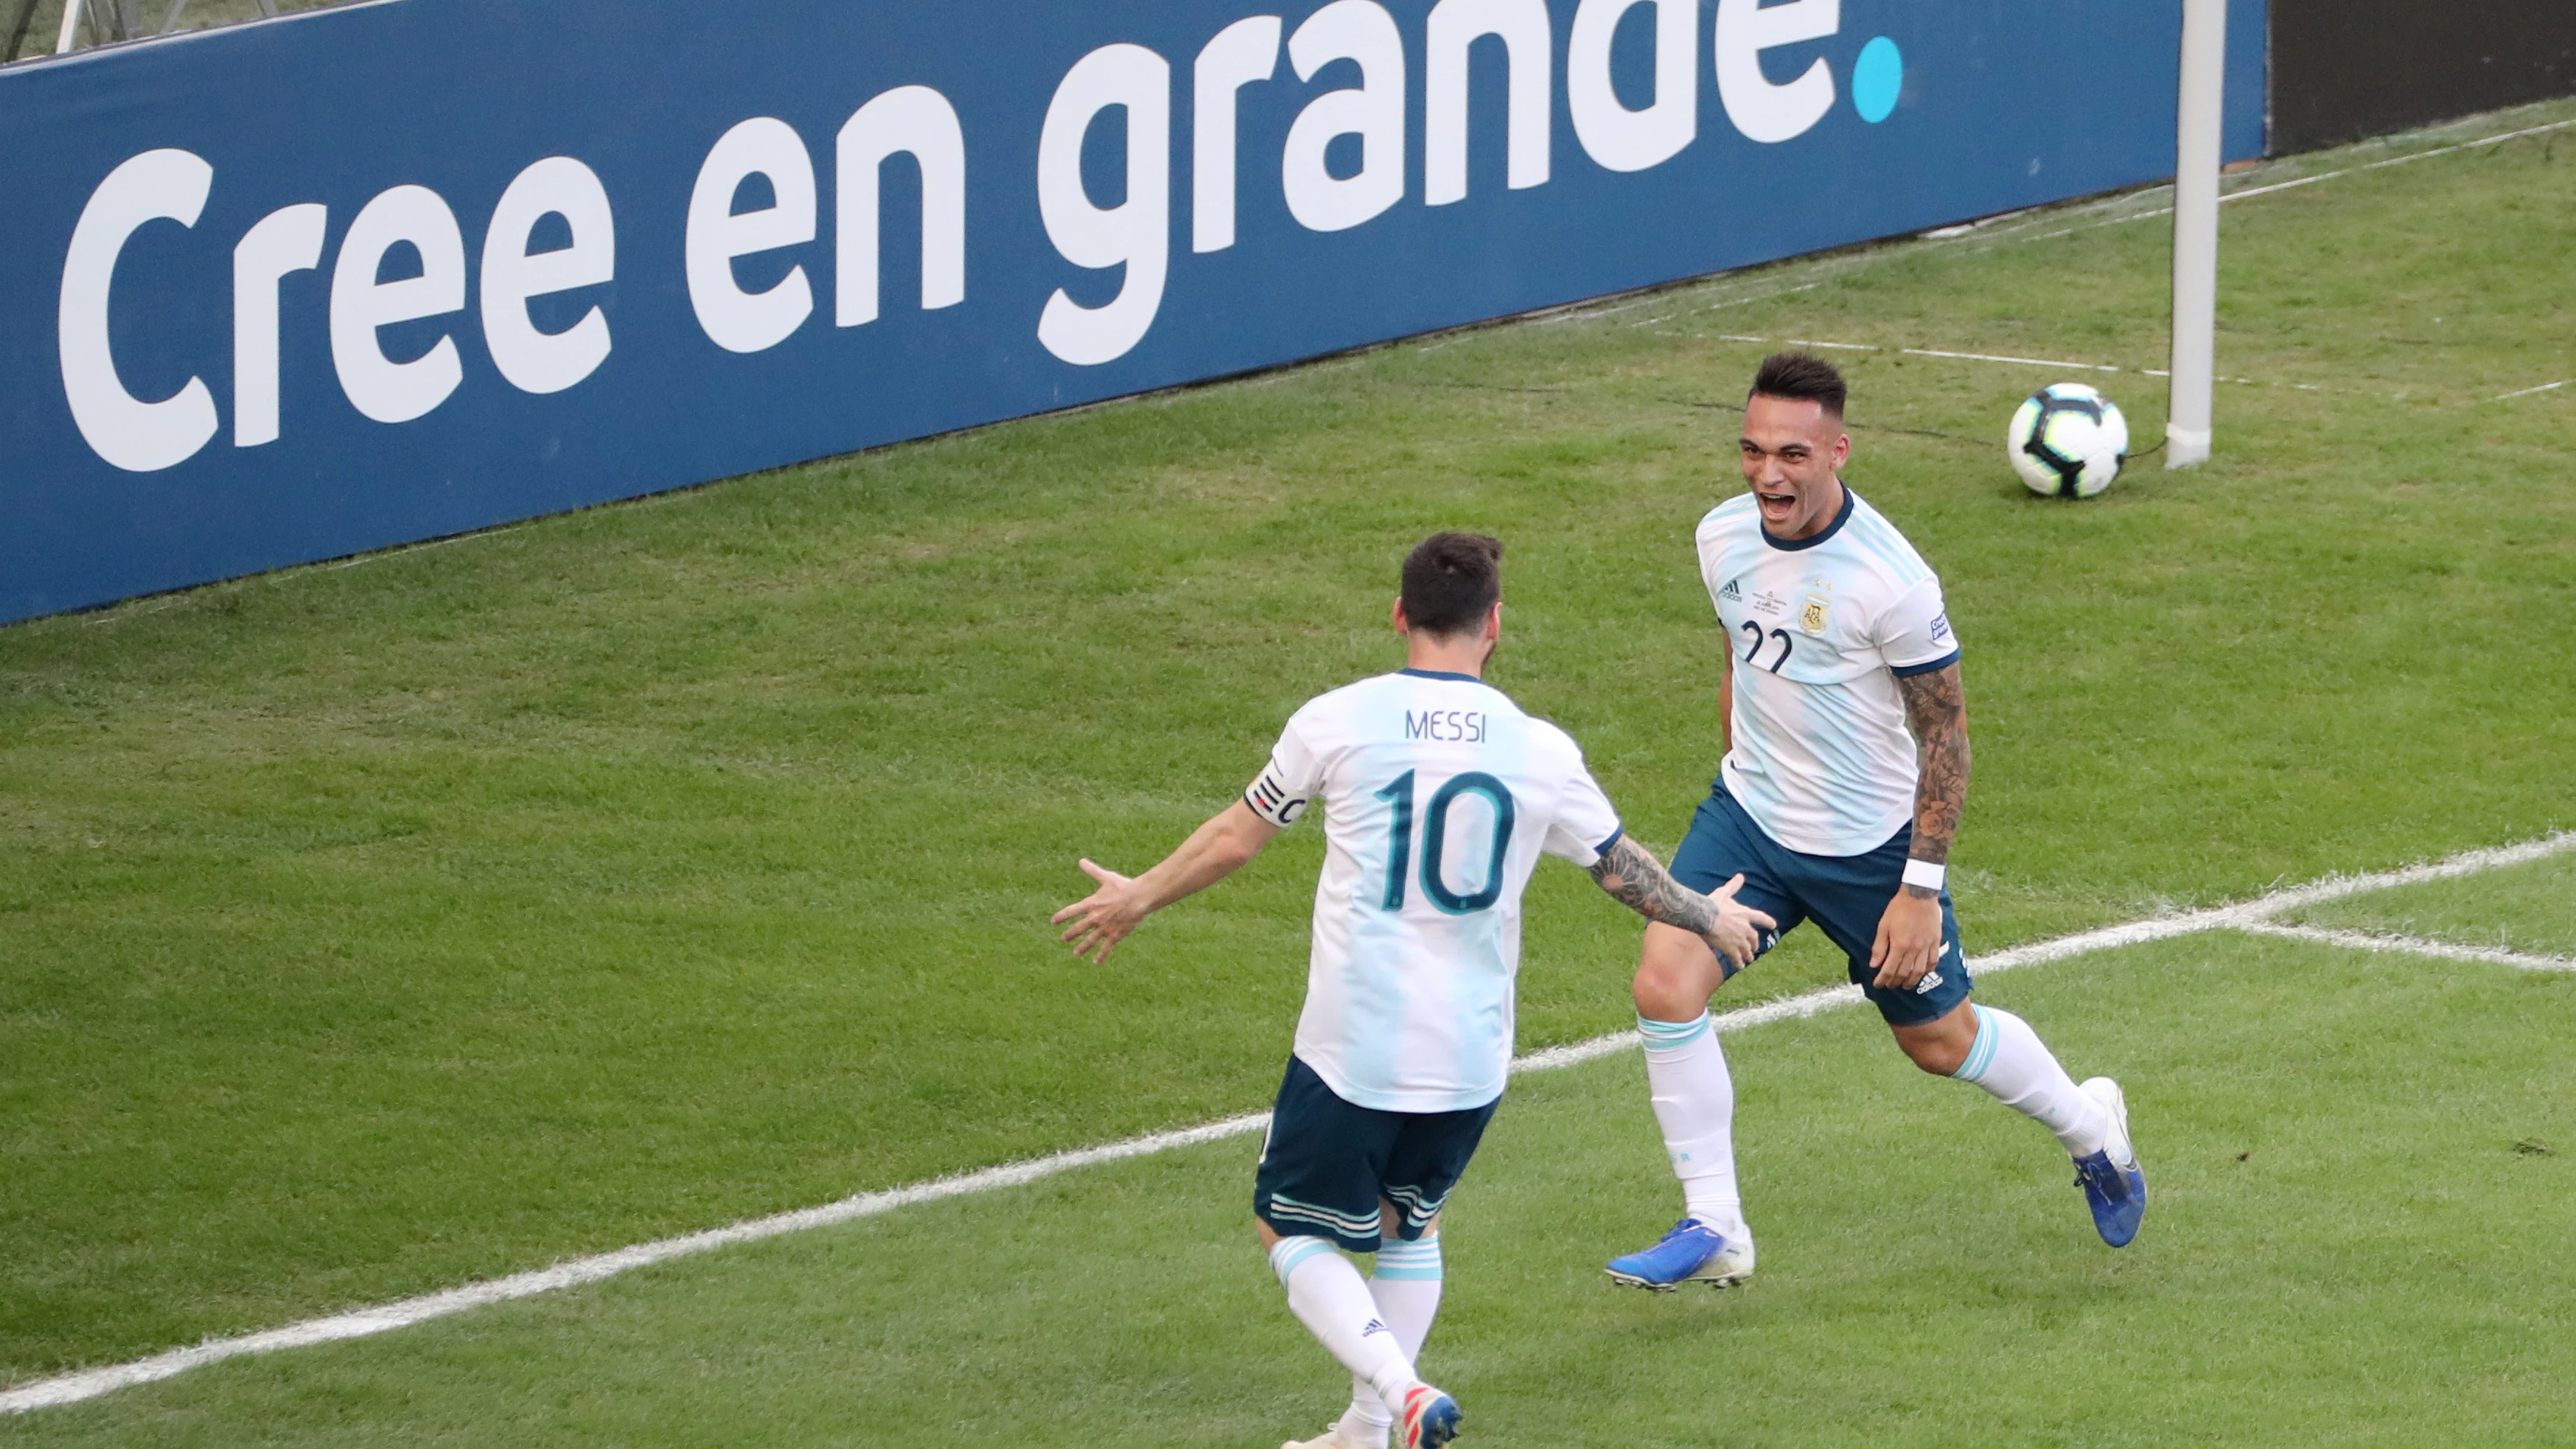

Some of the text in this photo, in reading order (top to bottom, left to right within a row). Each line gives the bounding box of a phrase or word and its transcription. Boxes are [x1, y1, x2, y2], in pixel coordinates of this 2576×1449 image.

[60, 149, 614, 471] Cree
[686, 85, 964, 352] en
[1406, 710, 1486, 744] MESSI
[1374, 768, 1515, 916] 10
[1916, 976, 1944, 995] adidas
